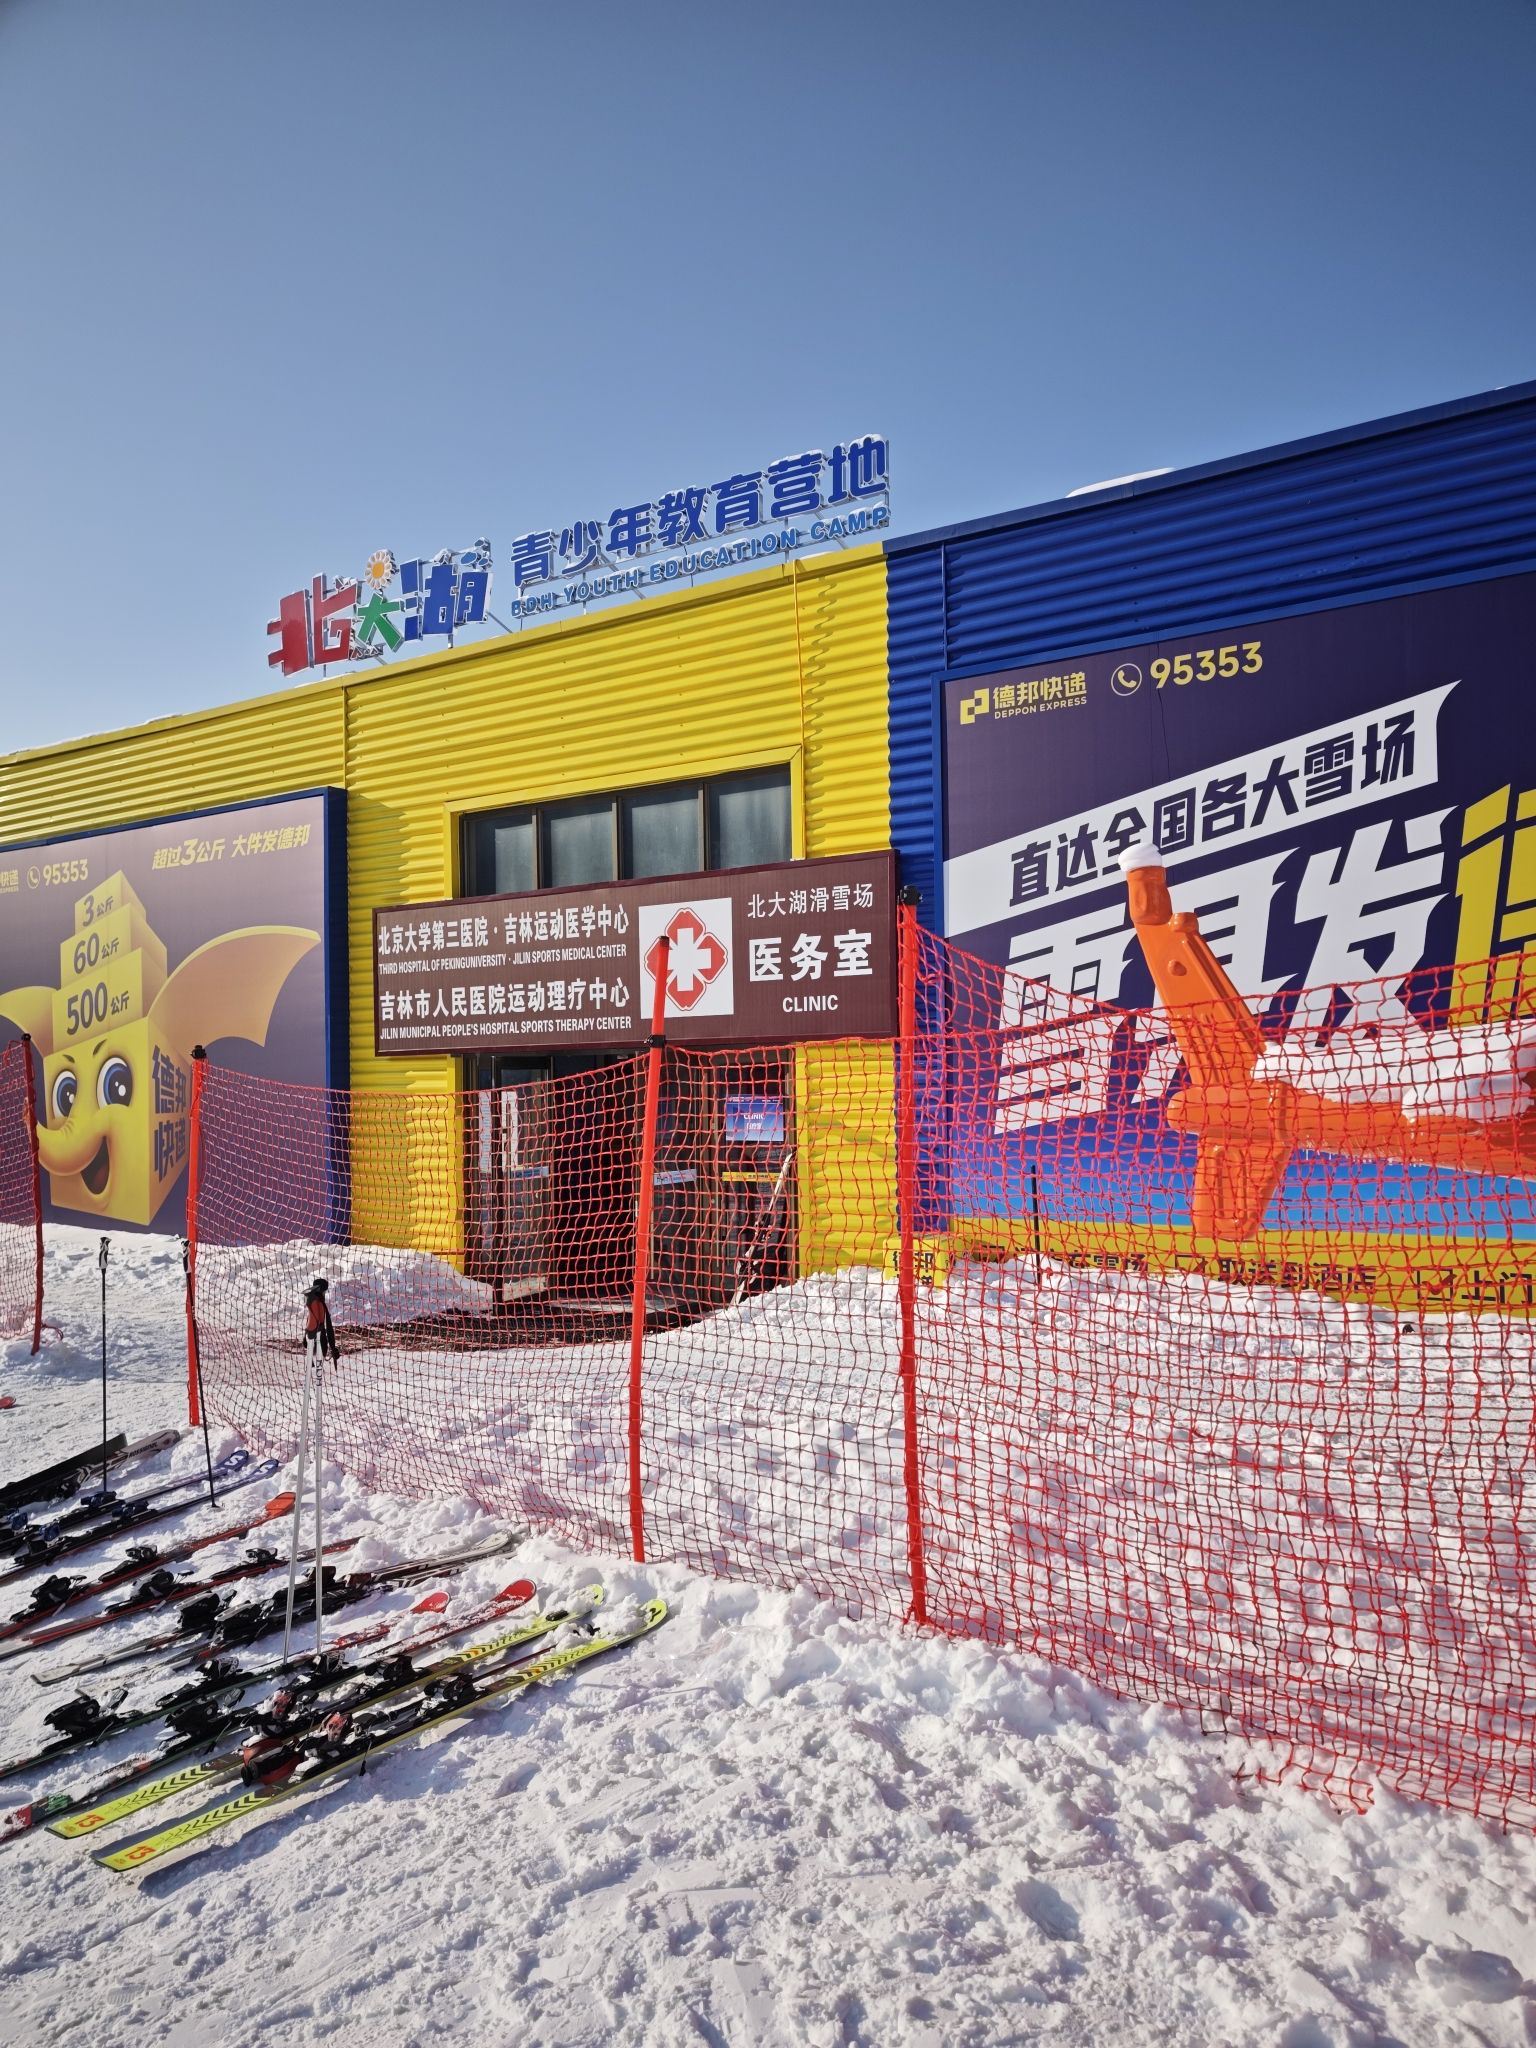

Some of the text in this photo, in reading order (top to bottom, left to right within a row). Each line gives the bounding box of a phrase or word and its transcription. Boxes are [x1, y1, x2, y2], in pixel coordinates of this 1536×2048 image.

[510, 435, 888, 587] 青少年教育营地
[511, 506, 888, 617] BDH YOUTH EDUCATION CAMP
[266, 545, 490, 677] 北大湖
[1150, 641, 1263, 689] 95353
[993, 671, 1087, 709] 德邦快递
[994, 696, 1087, 719] DEPPON EXPRESS
[1009, 709, 1416, 907] 直达全国各大雪场
[152, 824, 311, 870] 超过3公斤 大件发德邦
[43, 859, 88, 886] 95353
[747, 883, 873, 918] 北大湖滑雪场
[378, 962, 398, 975] THIRD
[398, 960, 430, 973] HOSPITAL
[431, 959, 440, 971] OF
[513, 951, 531, 965] JILIN
[531, 949, 561, 964] SPORTS
[561, 946, 595, 961] MEDICAL
[596, 943, 627, 959] CENTER
[749, 928, 873, 982] 医务室
[379, 976, 630, 1021] 吉林市人民医院运动理疗中心
[782, 994, 839, 1013] CLINIC
[380, 1015, 632, 1040] JILIN MUNICIPAL PEOPLE'S HOSPITAL SPORTS THERAPY CENTER
